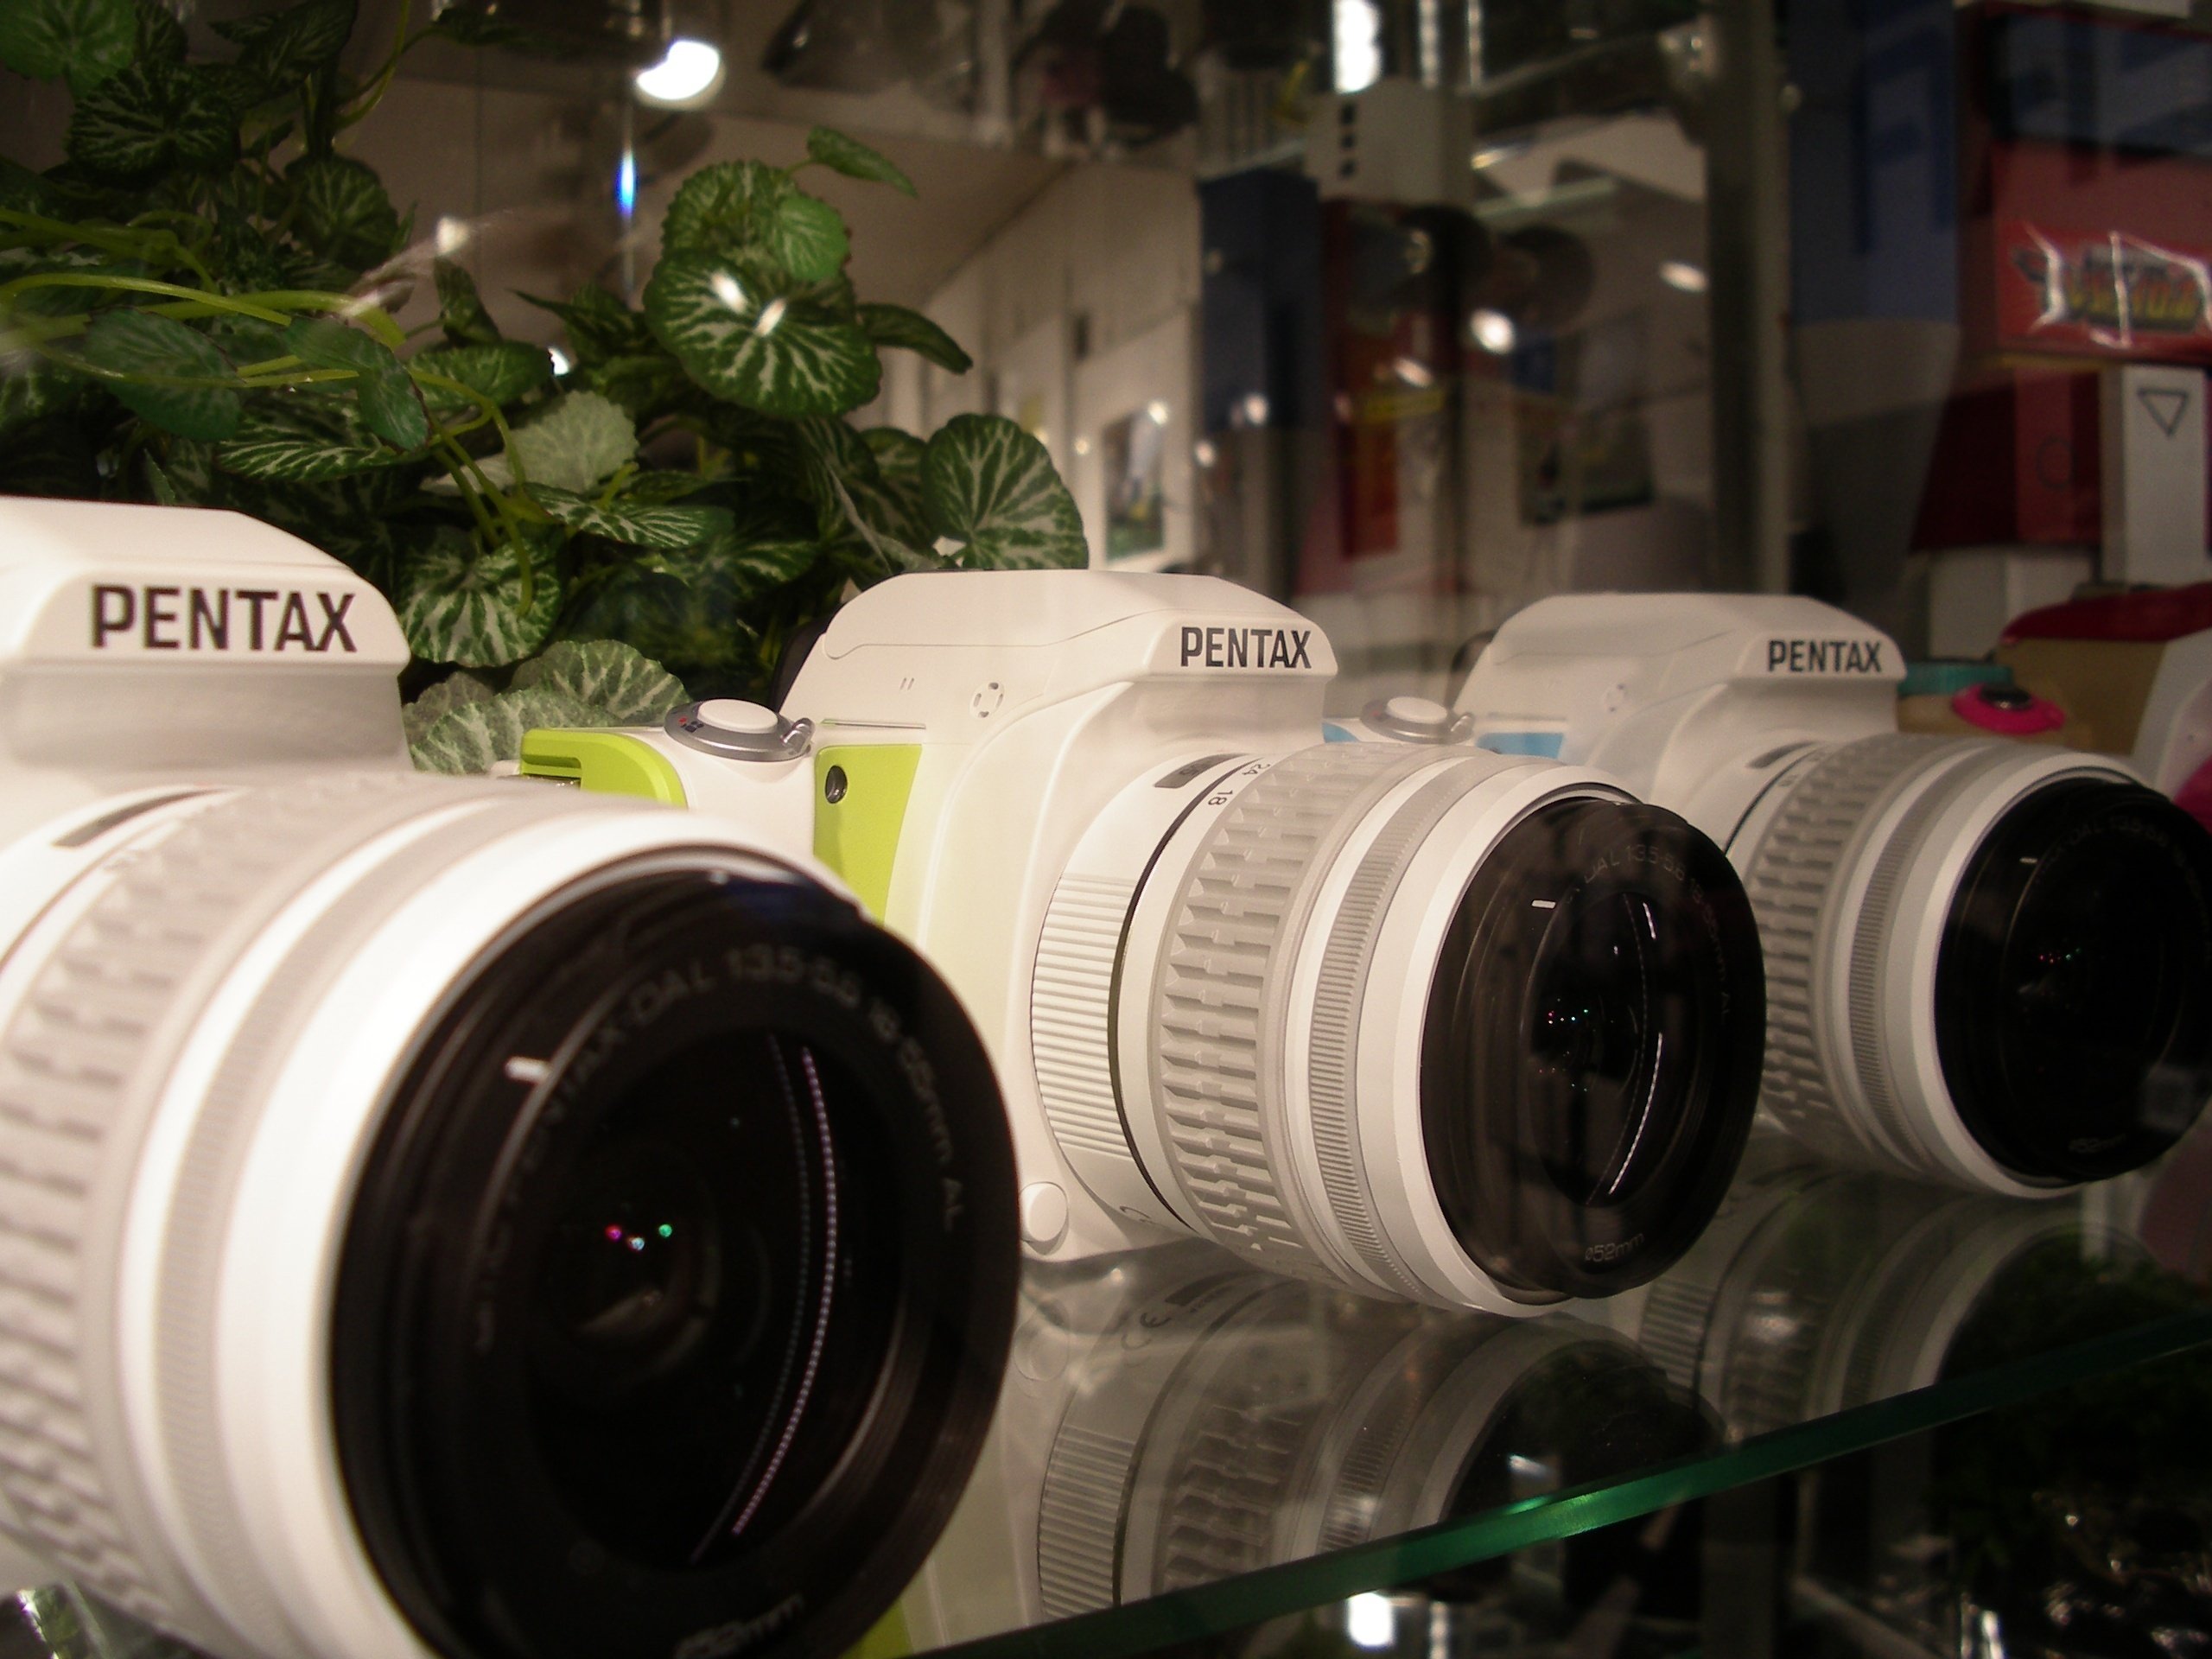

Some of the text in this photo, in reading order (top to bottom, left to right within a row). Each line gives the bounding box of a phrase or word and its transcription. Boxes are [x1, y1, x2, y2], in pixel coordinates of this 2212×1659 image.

[91, 585, 358, 652] PENTAX
[1180, 626, 1312, 669] PENTAX
[1769, 639, 1882, 672] PENTAX
[1208, 764, 1271, 805] 24 18
